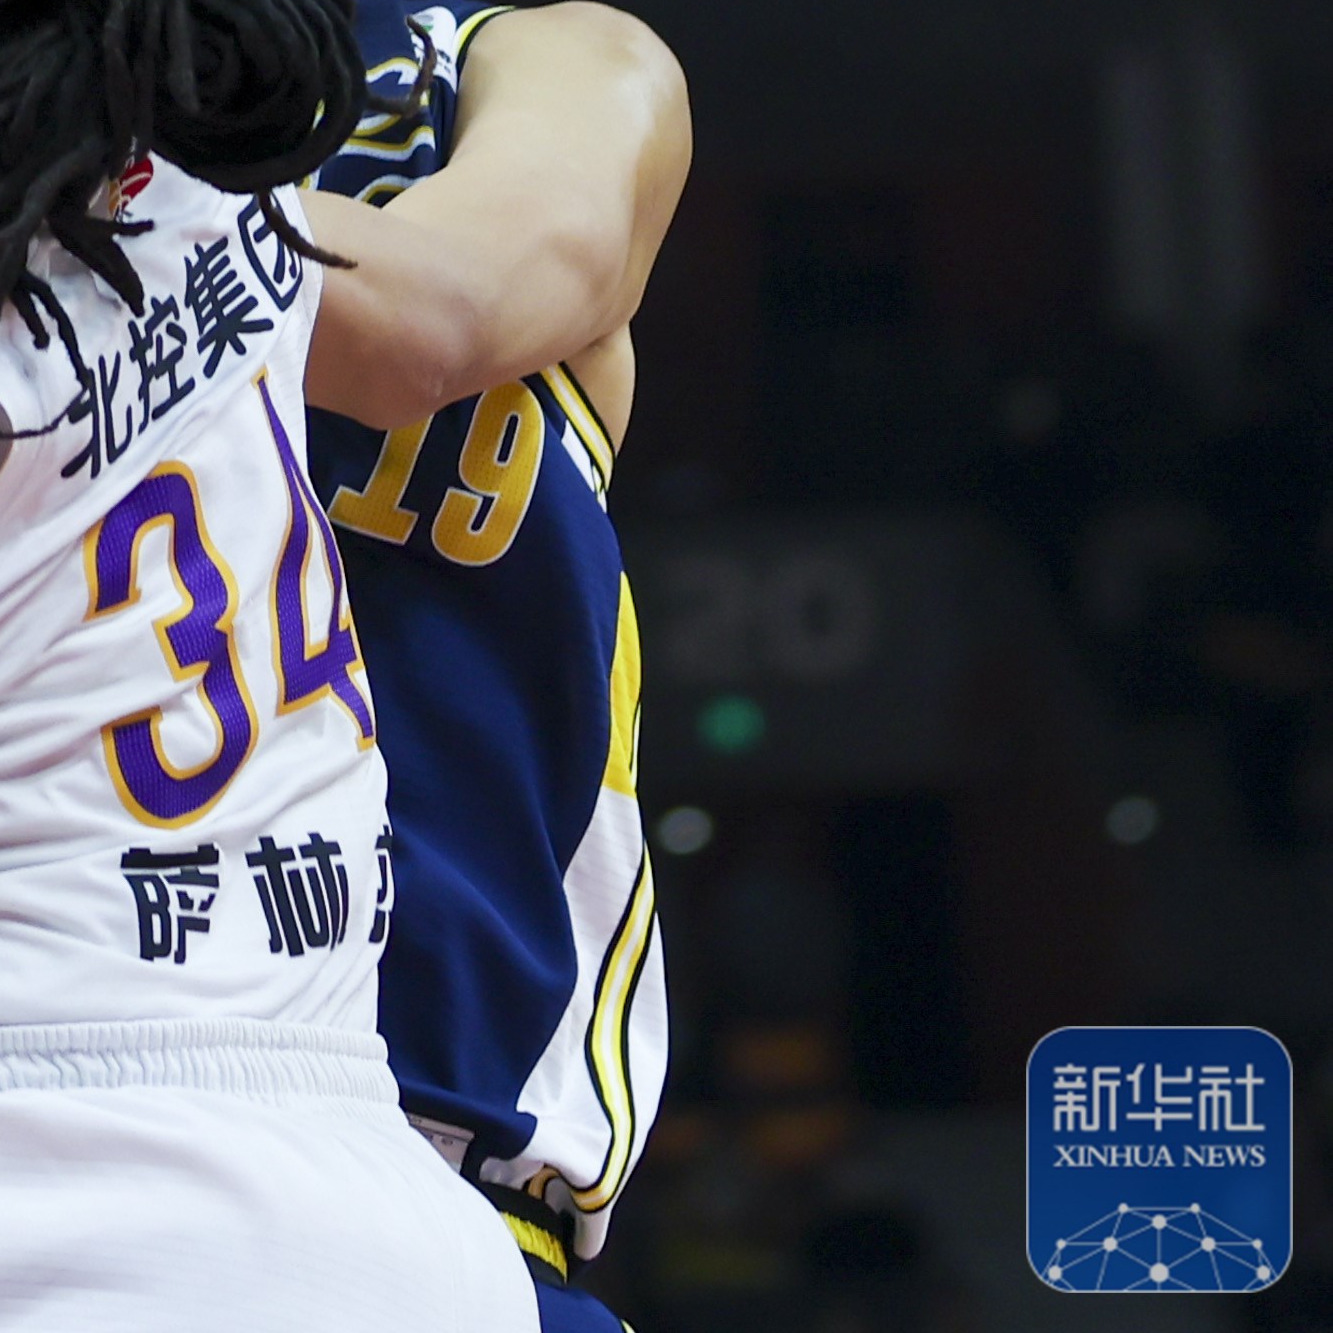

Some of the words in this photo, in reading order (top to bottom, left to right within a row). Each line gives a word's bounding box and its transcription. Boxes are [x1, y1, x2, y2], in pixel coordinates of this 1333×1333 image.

[61, 192, 305, 480] 北控集团
[329, 379, 544, 567] 19
[83, 364, 377, 830] 34
